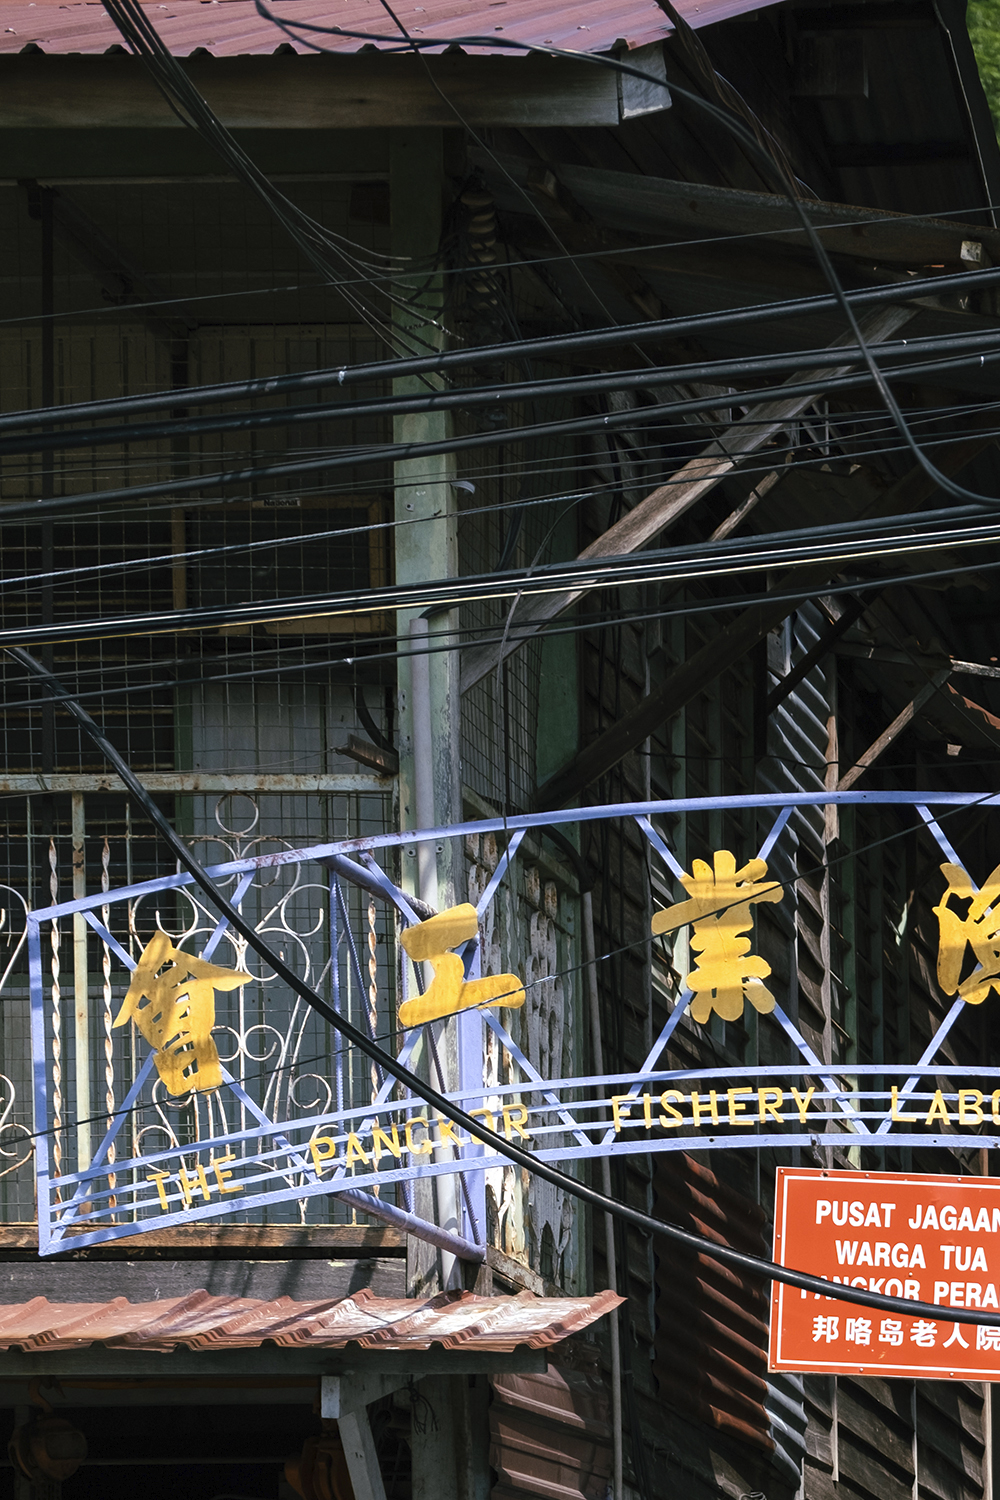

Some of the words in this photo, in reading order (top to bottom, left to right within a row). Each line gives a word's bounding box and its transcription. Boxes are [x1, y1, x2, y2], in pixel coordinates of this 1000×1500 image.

[146, 1154, 244, 1210] THE
[308, 1103, 530, 1176] PANGKOR
[611, 1086, 815, 1132] FISHERY
[815, 1200, 896, 1228] PUSAT
[835, 1240, 926, 1269] WARGA
[940, 1245, 988, 1272] TUA
